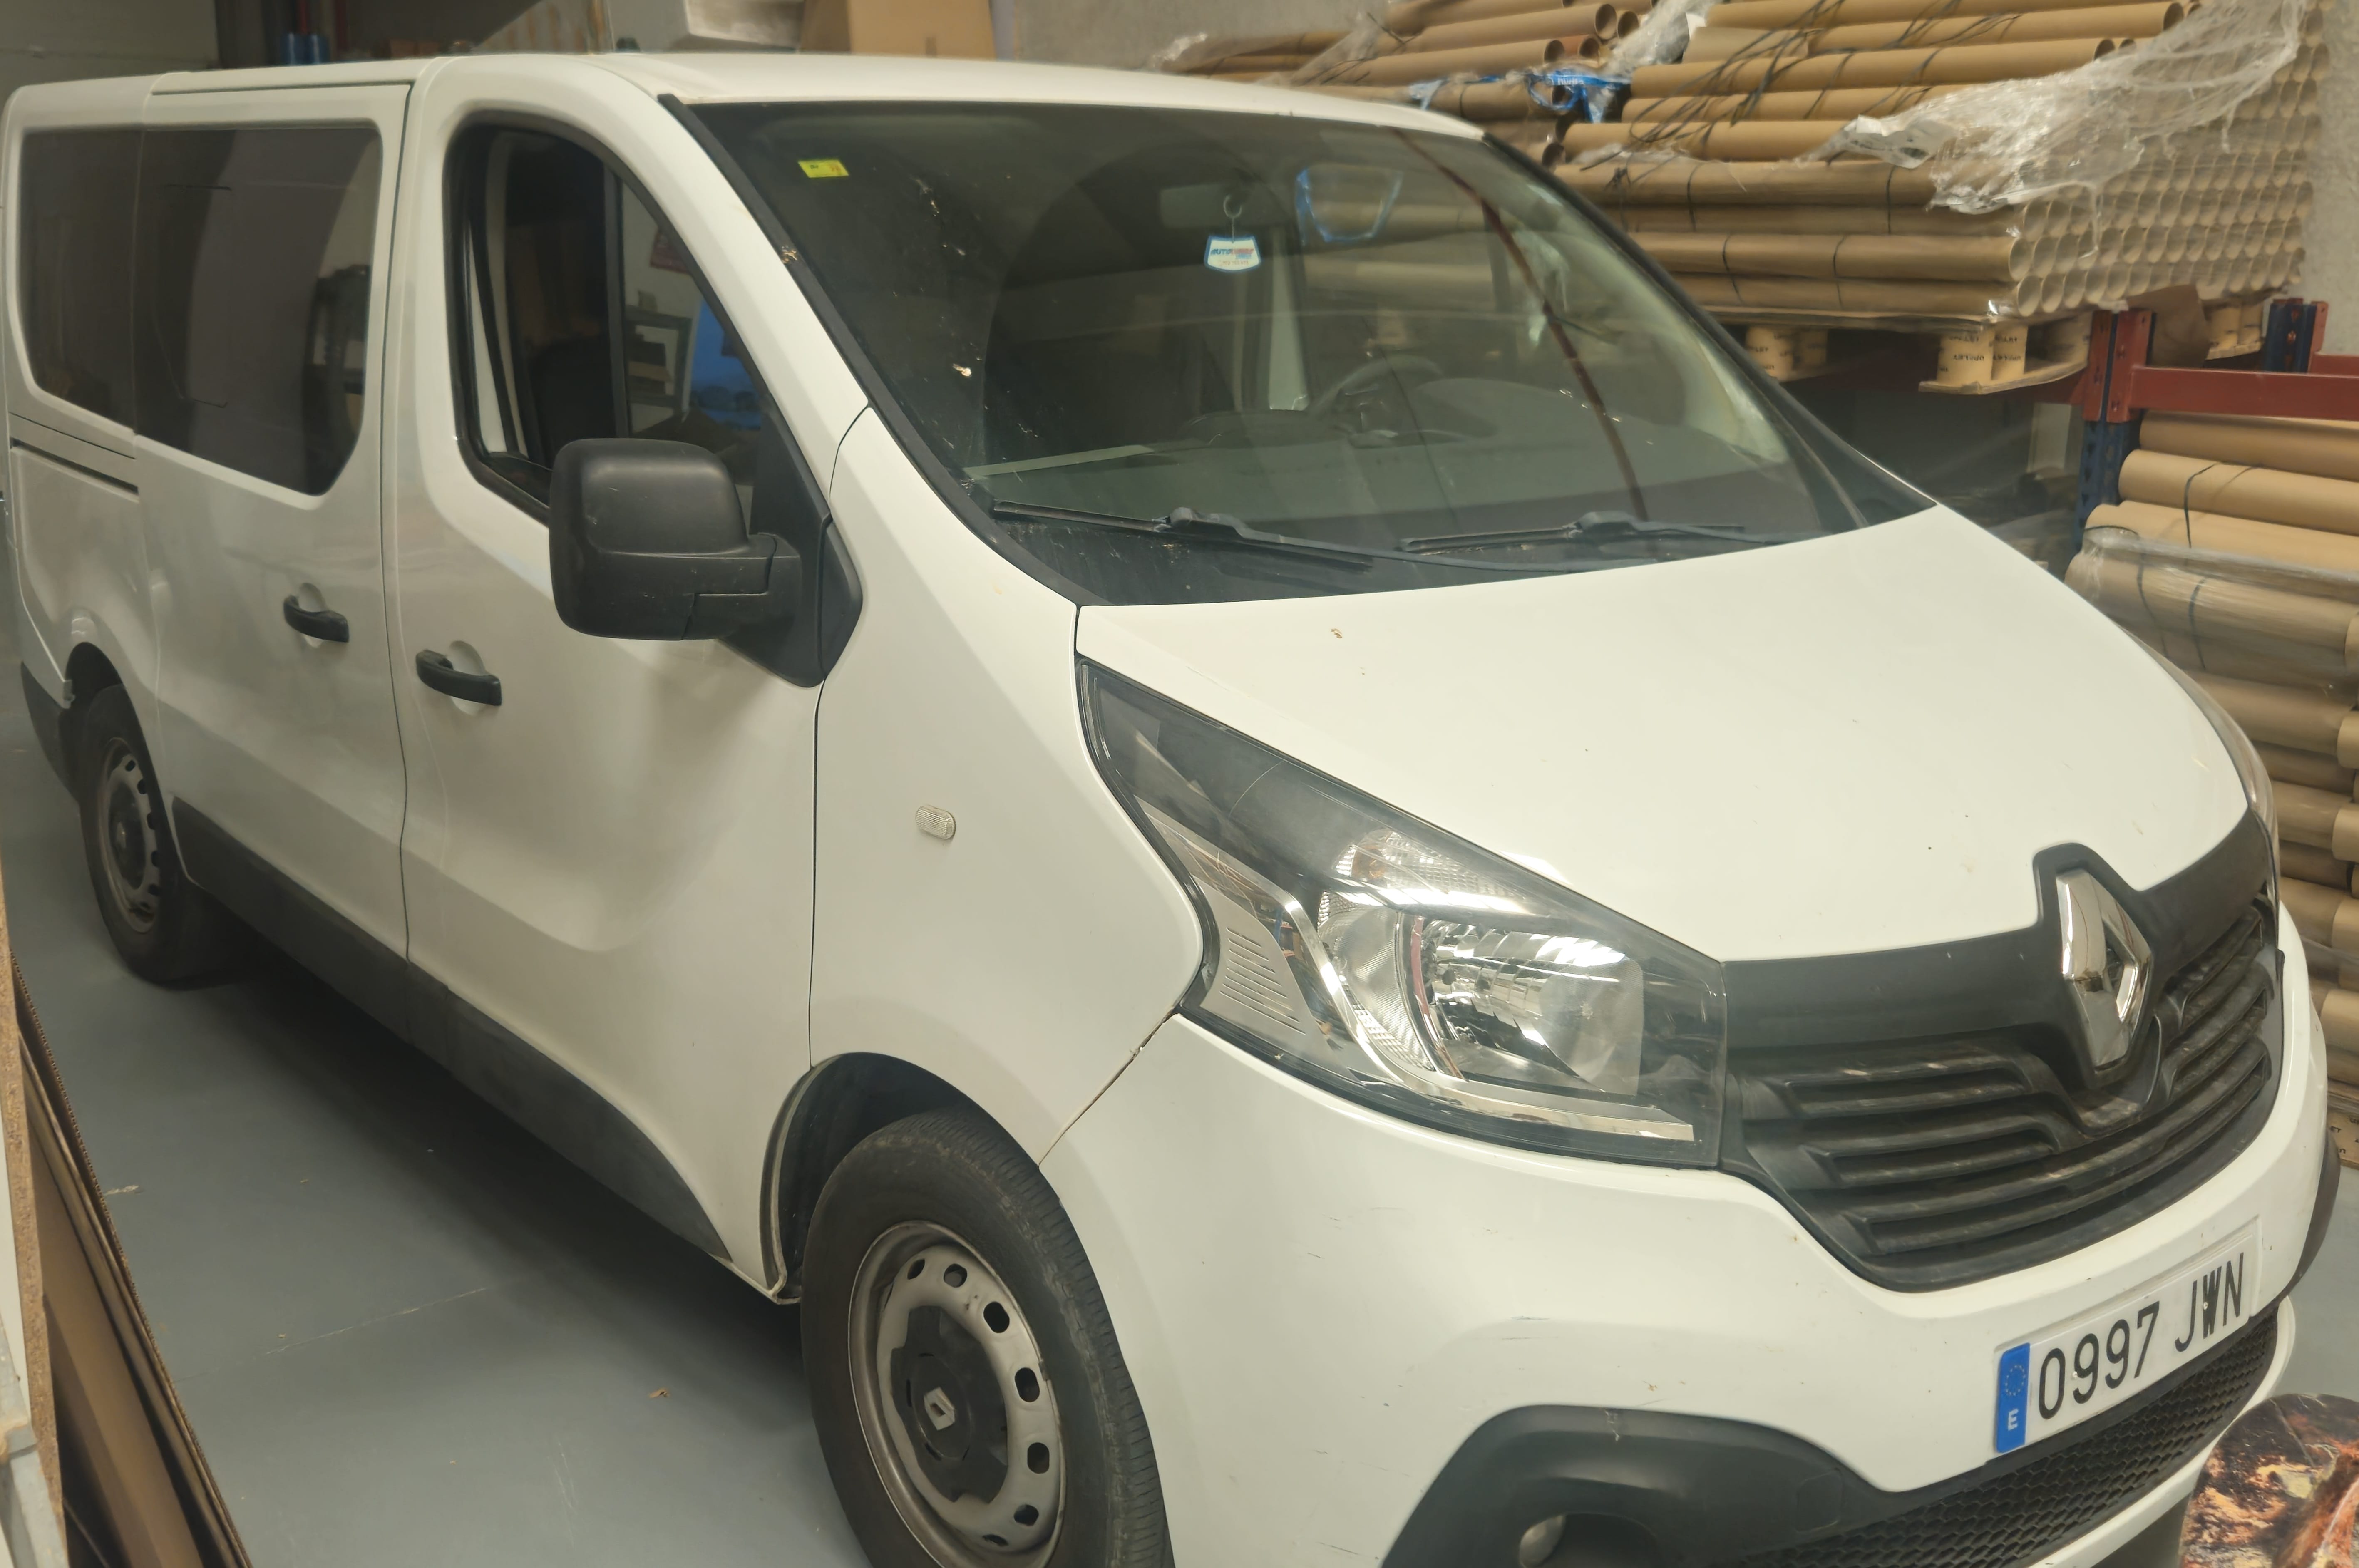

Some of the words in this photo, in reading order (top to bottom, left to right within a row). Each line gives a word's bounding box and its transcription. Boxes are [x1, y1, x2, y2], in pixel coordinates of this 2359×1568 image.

[2039, 1301, 2160, 1420] 0997
[2175, 1252, 2244, 1352] JWN
[2007, 1408, 2019, 1431] E
